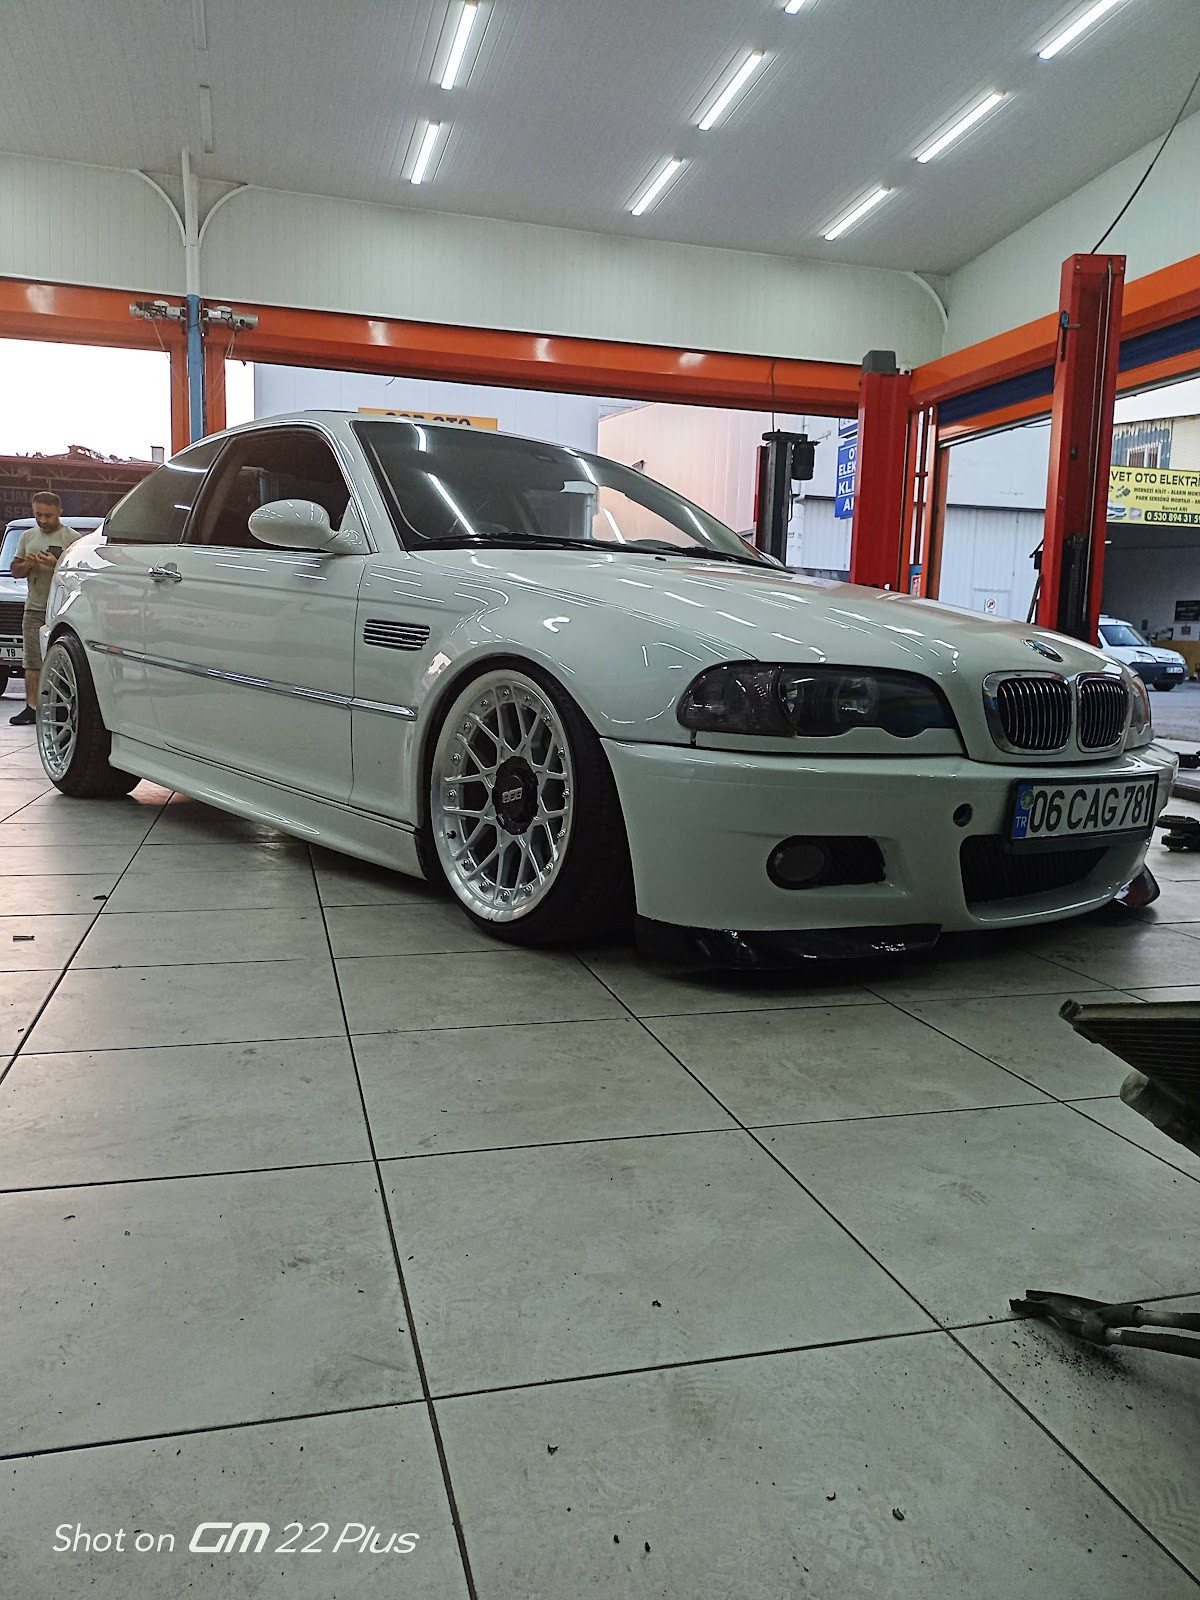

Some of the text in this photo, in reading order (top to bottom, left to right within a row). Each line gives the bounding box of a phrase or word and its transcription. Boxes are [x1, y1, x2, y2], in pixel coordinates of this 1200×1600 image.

[1111, 471, 1132, 482] VET
[1135, 473, 1157, 484] OTO
[1154, 512, 1168, 521] 530
[1015, 783, 1153, 833] TR 06 CAG 781
